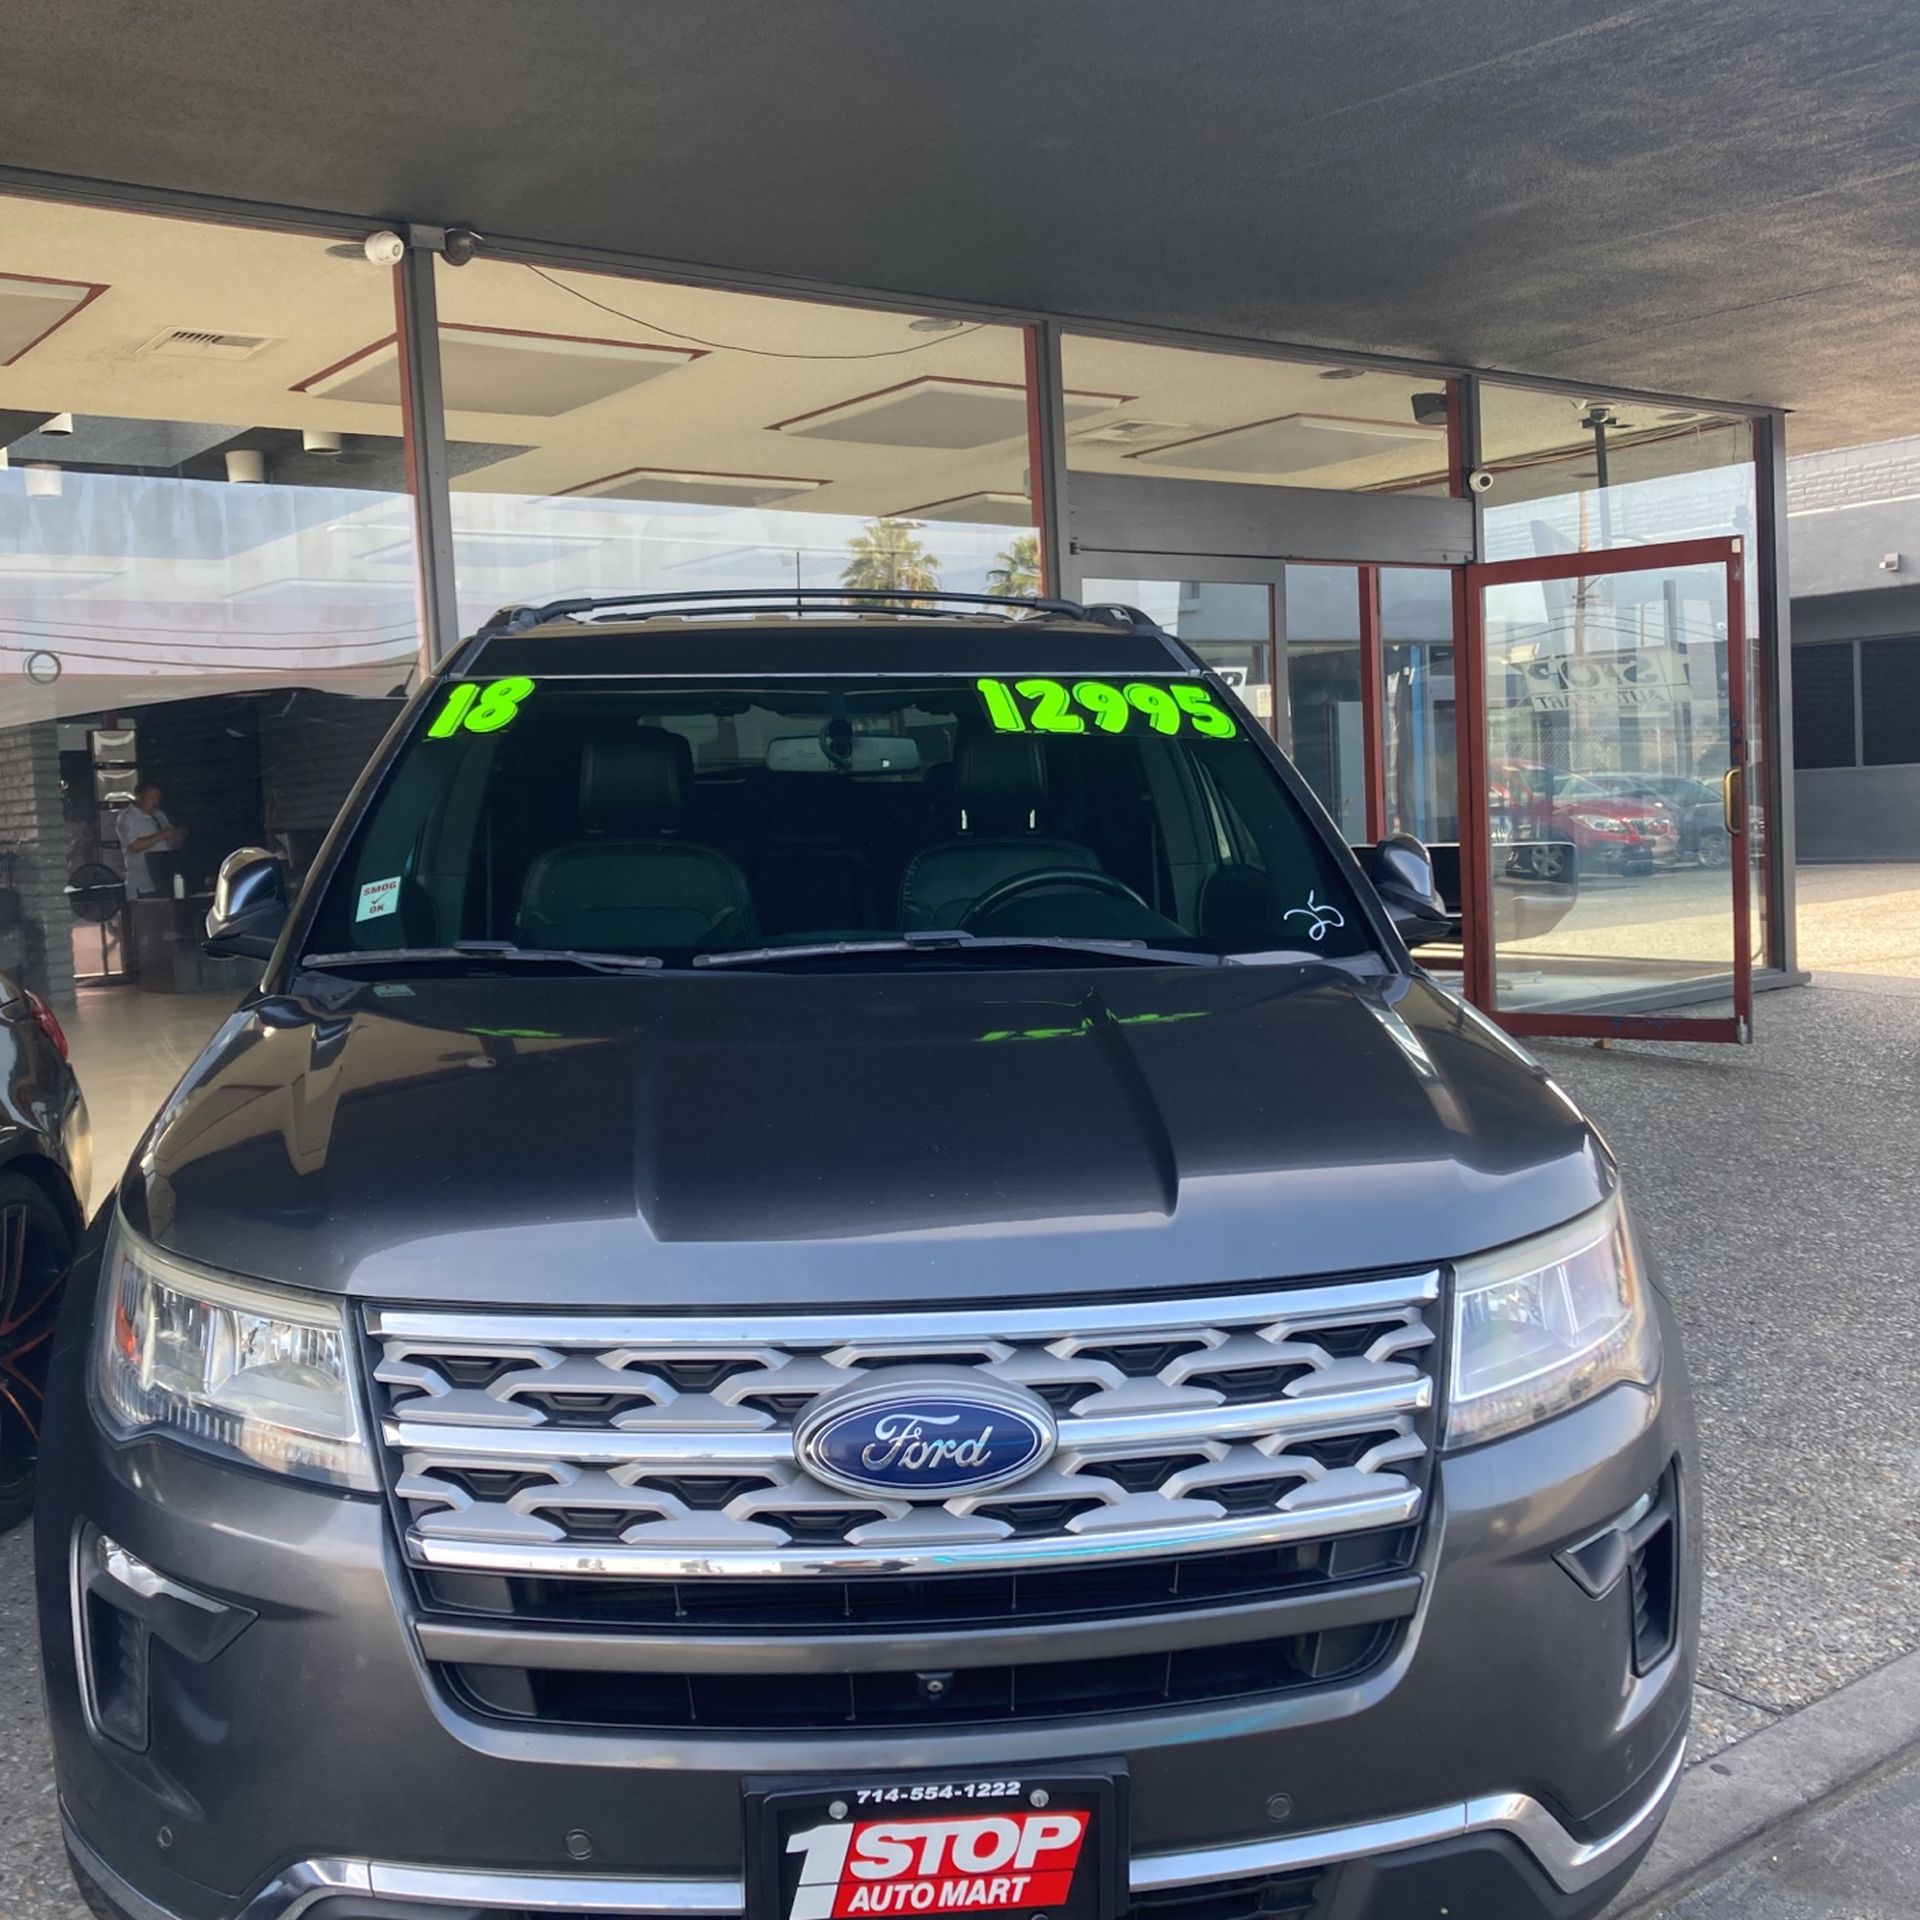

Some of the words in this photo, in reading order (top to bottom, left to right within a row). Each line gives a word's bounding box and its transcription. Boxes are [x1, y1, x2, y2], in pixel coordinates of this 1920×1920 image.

[427, 677, 536, 738] 18
[976, 678, 1237, 739] 12995
[363, 880, 397, 896] SMOG
[369, 903, 385, 914] OK
[861, 1413, 994, 1472] Ford
[856, 1780, 1022, 1804] 714-554-1222
[785, 1822, 854, 1920] 1
[849, 1815, 1082, 1880] STOP
[847, 1882, 935, 1913] AUTO
[938, 1876, 1032, 1908] MART
